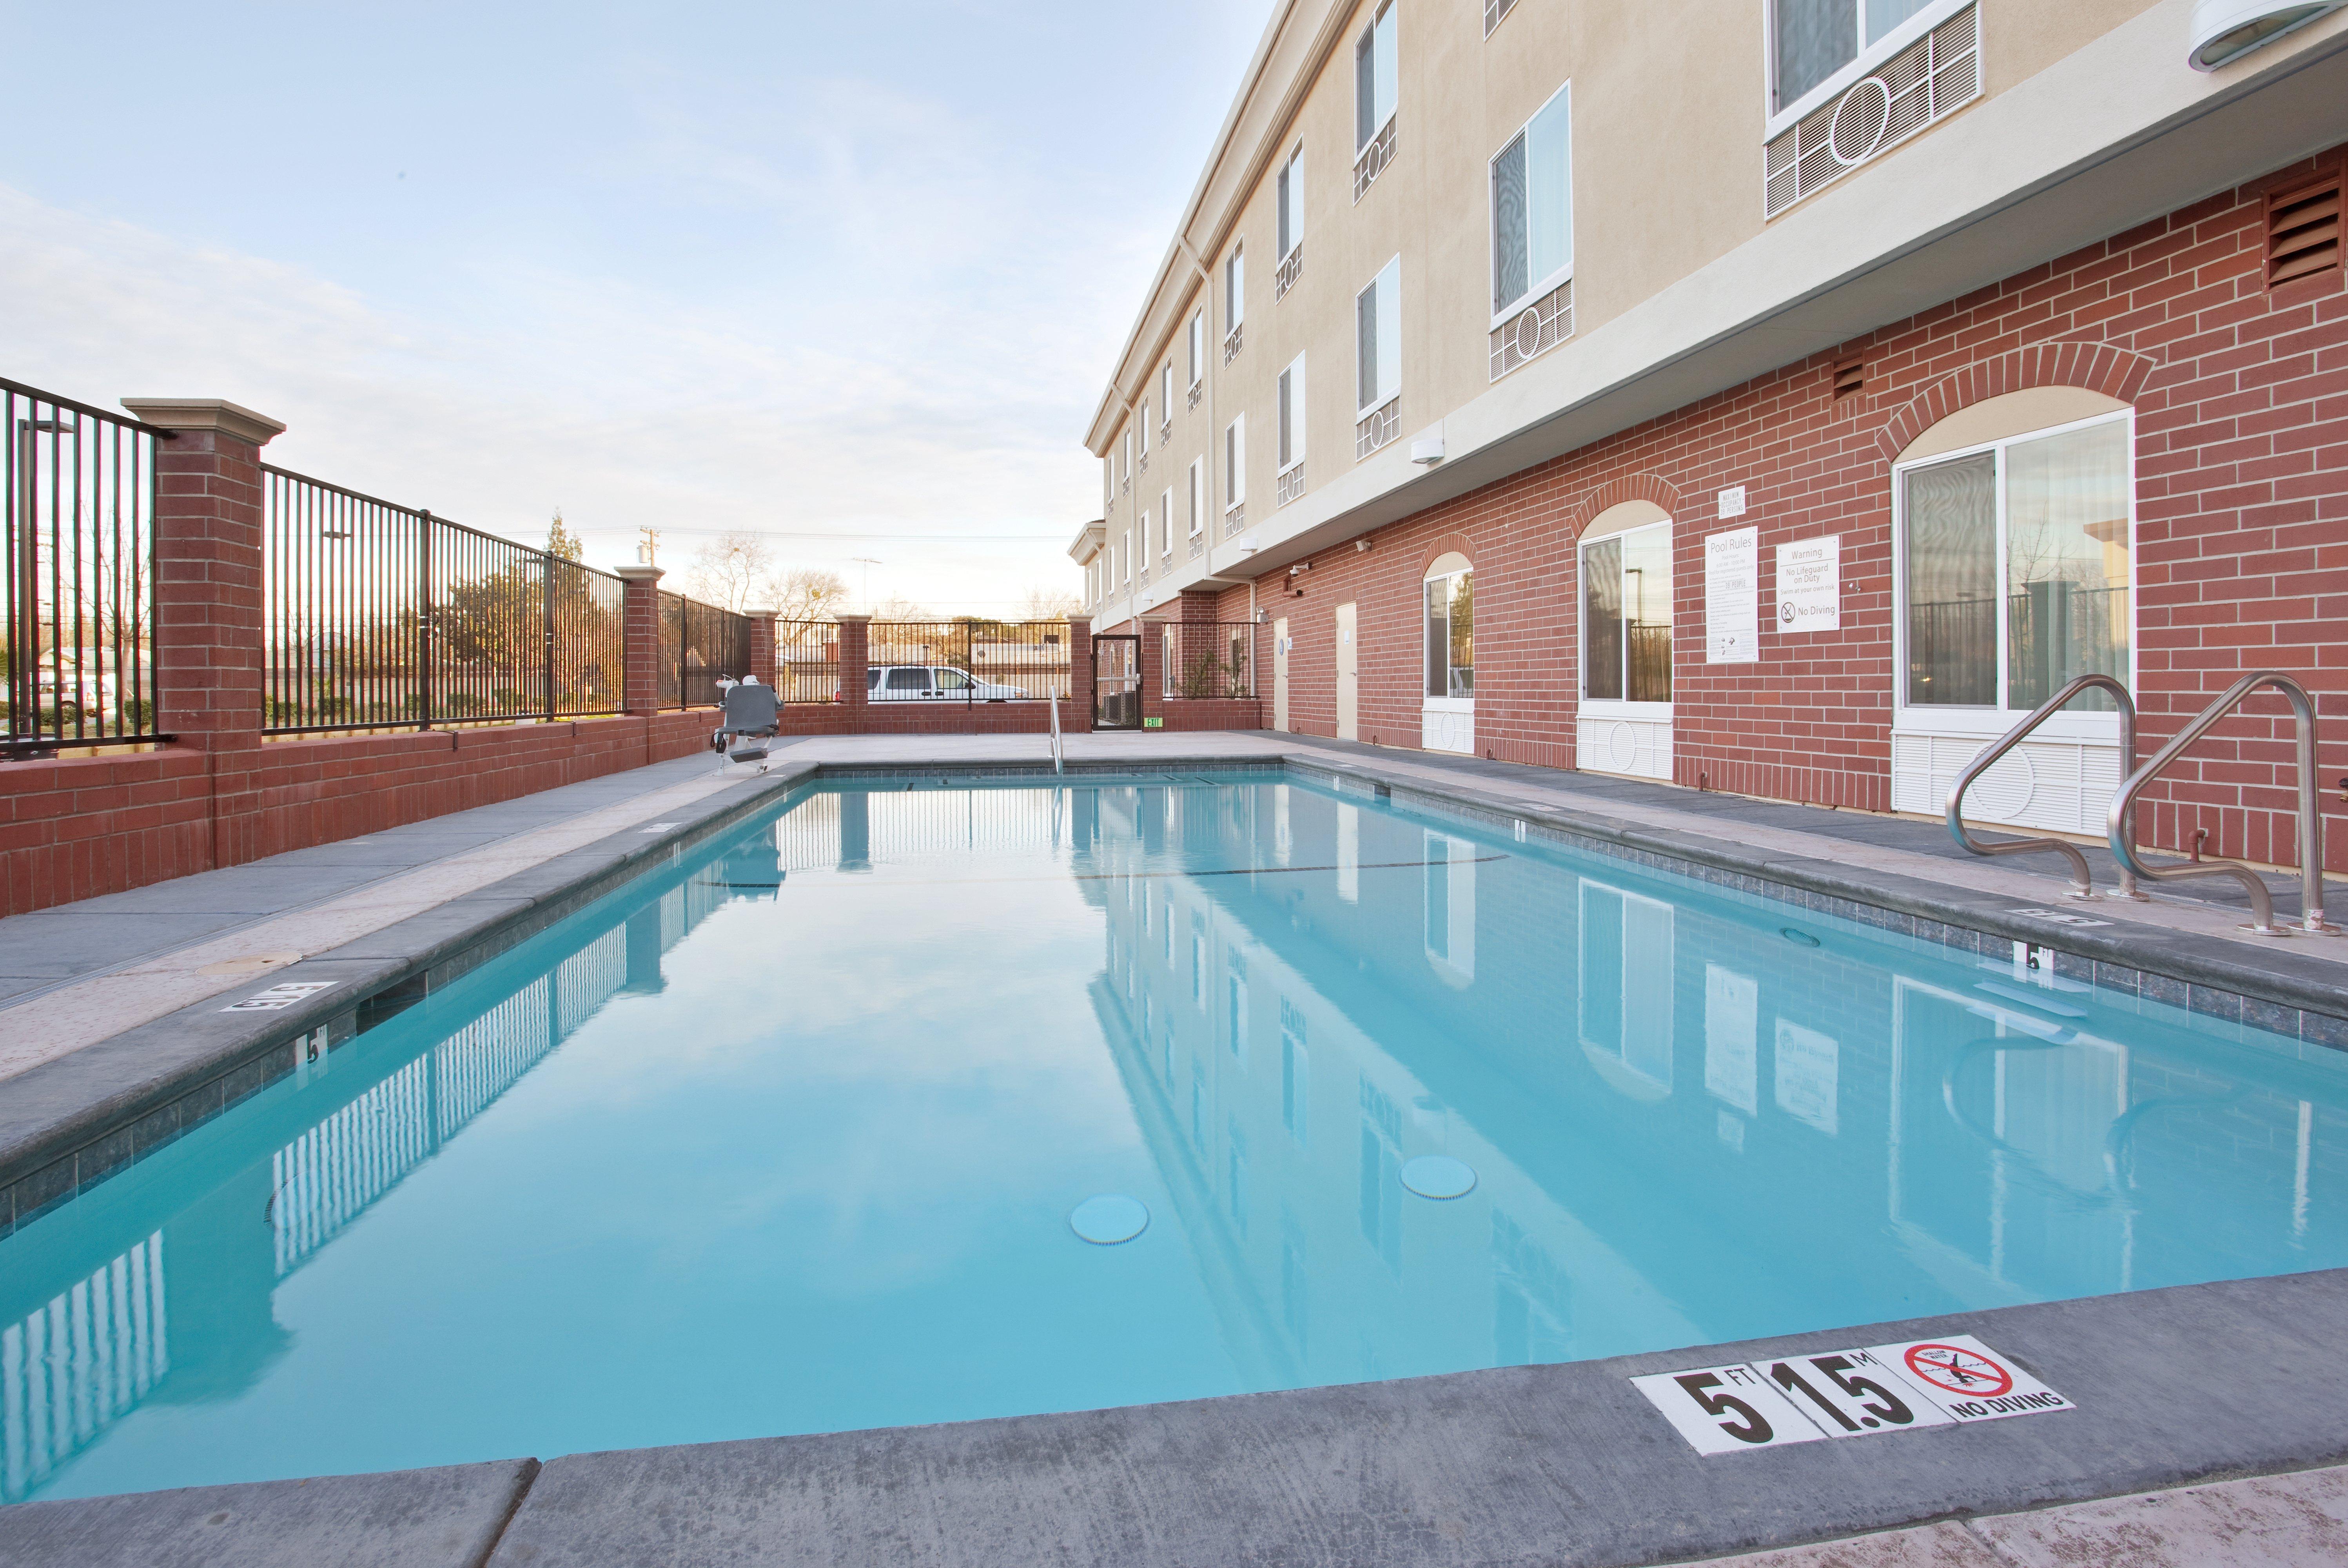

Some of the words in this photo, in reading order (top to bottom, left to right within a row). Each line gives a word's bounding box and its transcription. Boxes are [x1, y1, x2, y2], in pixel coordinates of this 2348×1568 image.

[1723, 491, 1739, 501] MAXIMUM
[1721, 497, 1741, 508] OCCUPANCY
[1727, 504, 1743, 514] PERSONS
[1711, 539, 1727, 554] Pool
[1729, 537, 1751, 550] Rules
[1791, 548, 1822, 559] Warning
[1797, 563, 1828, 576] Lifeguard
[1732, 580, 1746, 588] PEOPLE
[1804, 575, 1820, 583] Duty
[1798, 607, 1808, 615] No
[1810, 605, 1835, 616] Diving
[1148, 718, 1159, 726] EXIT
[2026, 943, 2040, 970] 5
[307, 1028, 319, 1064] 5
[1673, 1372, 1774, 1444] 5
[1724, 1369, 1757, 1386] FT
[1770, 1356, 1914, 1432] 1.5
[1850, 1353, 1878, 1367] M
[1949, 1402, 1989, 1418] NO
[1983, 1392, 2064, 1413] DIVING
